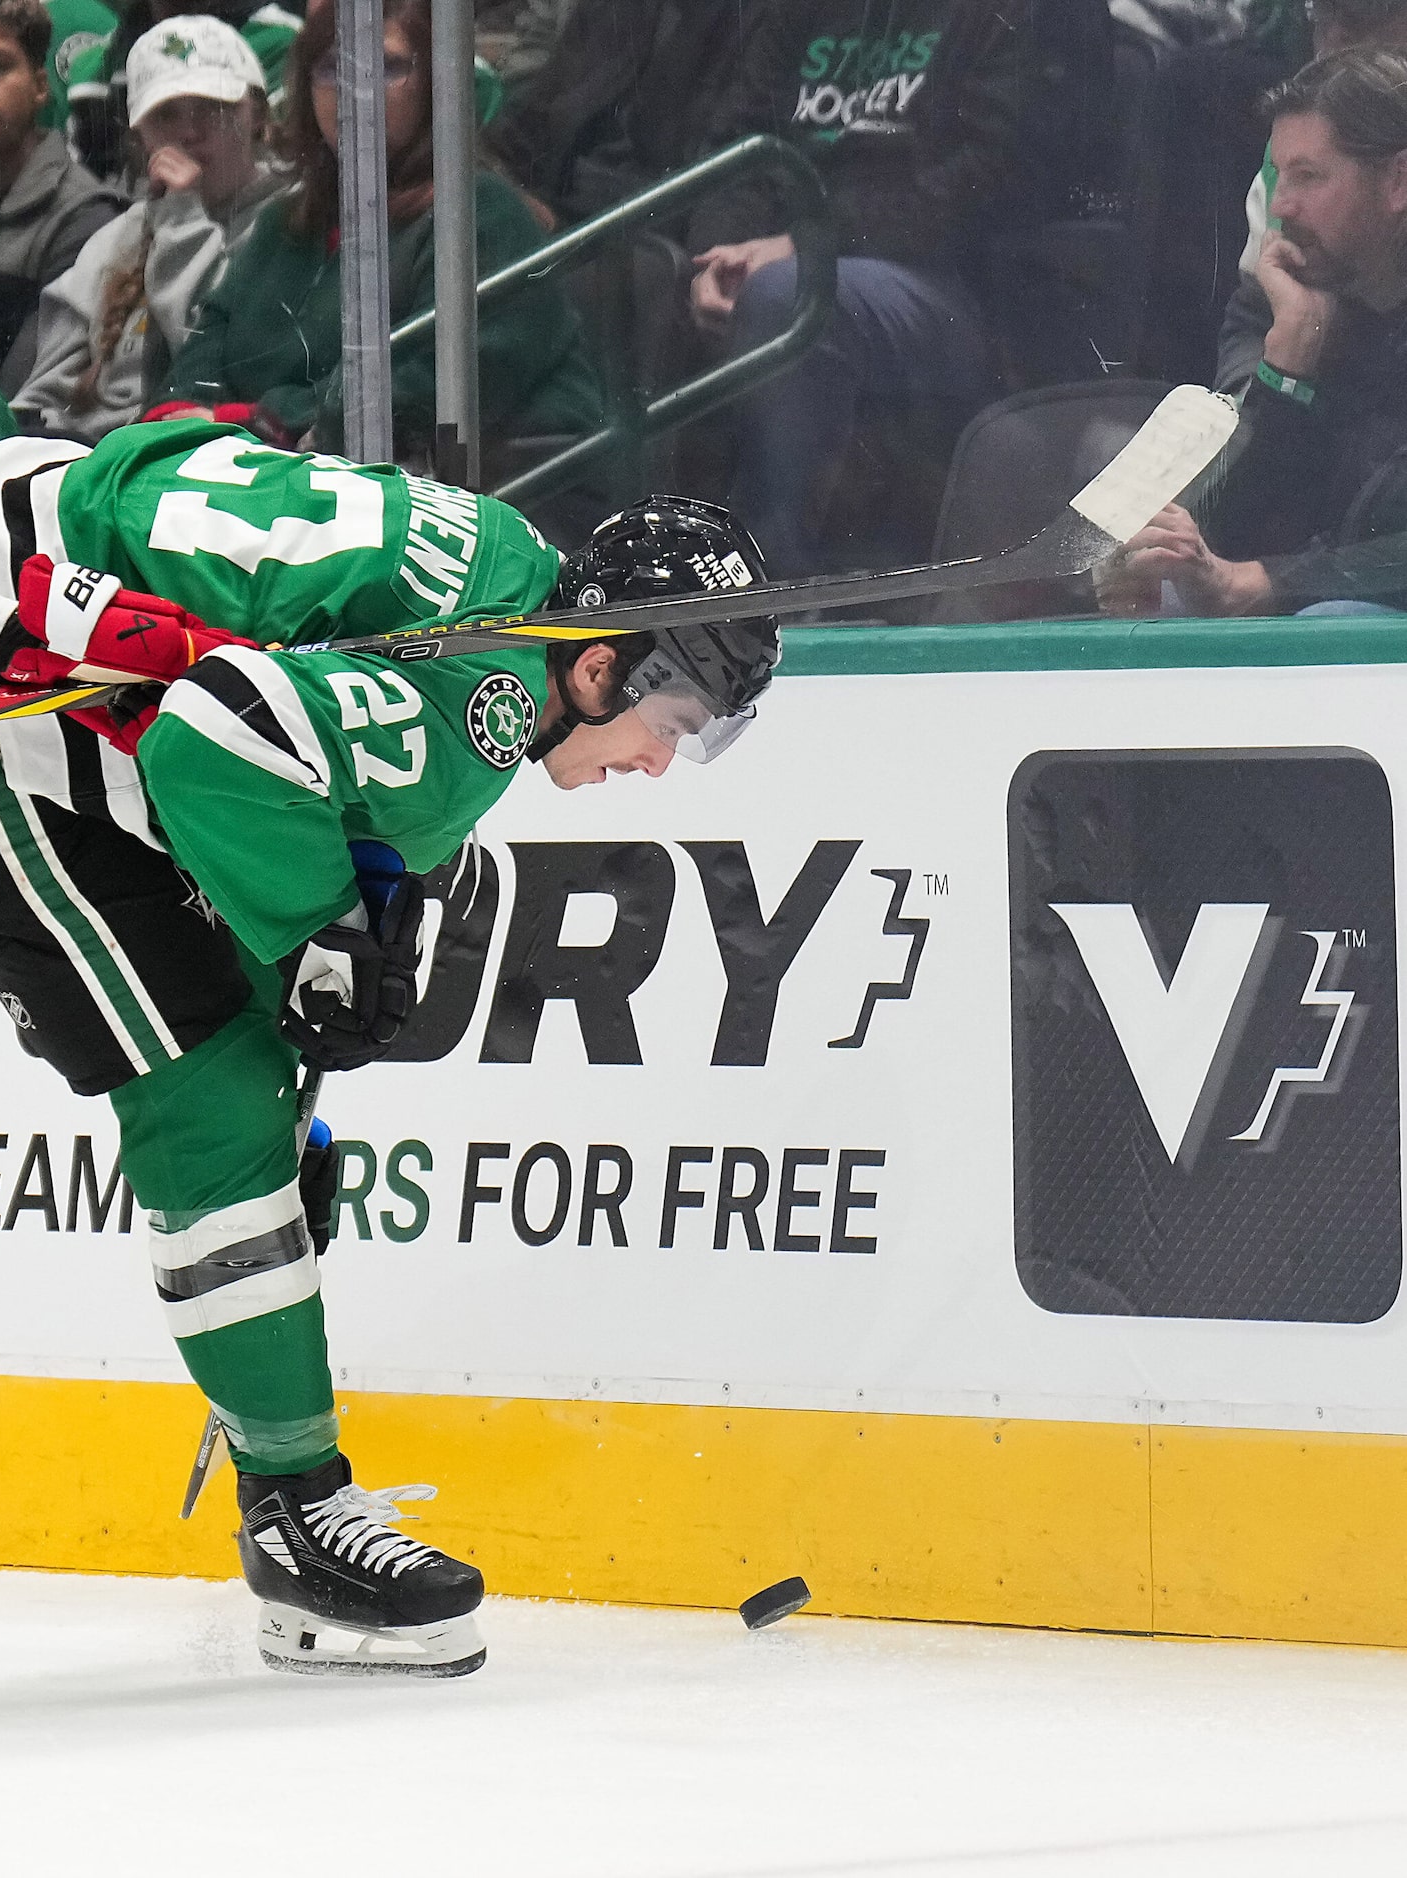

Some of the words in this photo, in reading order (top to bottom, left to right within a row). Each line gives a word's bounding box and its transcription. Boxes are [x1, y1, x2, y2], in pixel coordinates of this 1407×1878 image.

[684, 553, 718, 591] TRAN
[703, 552, 732, 589] ENER
[324, 669, 427, 788] 27
[458, 1141, 634, 1248] FOR
[659, 1145, 887, 1254] FREE
